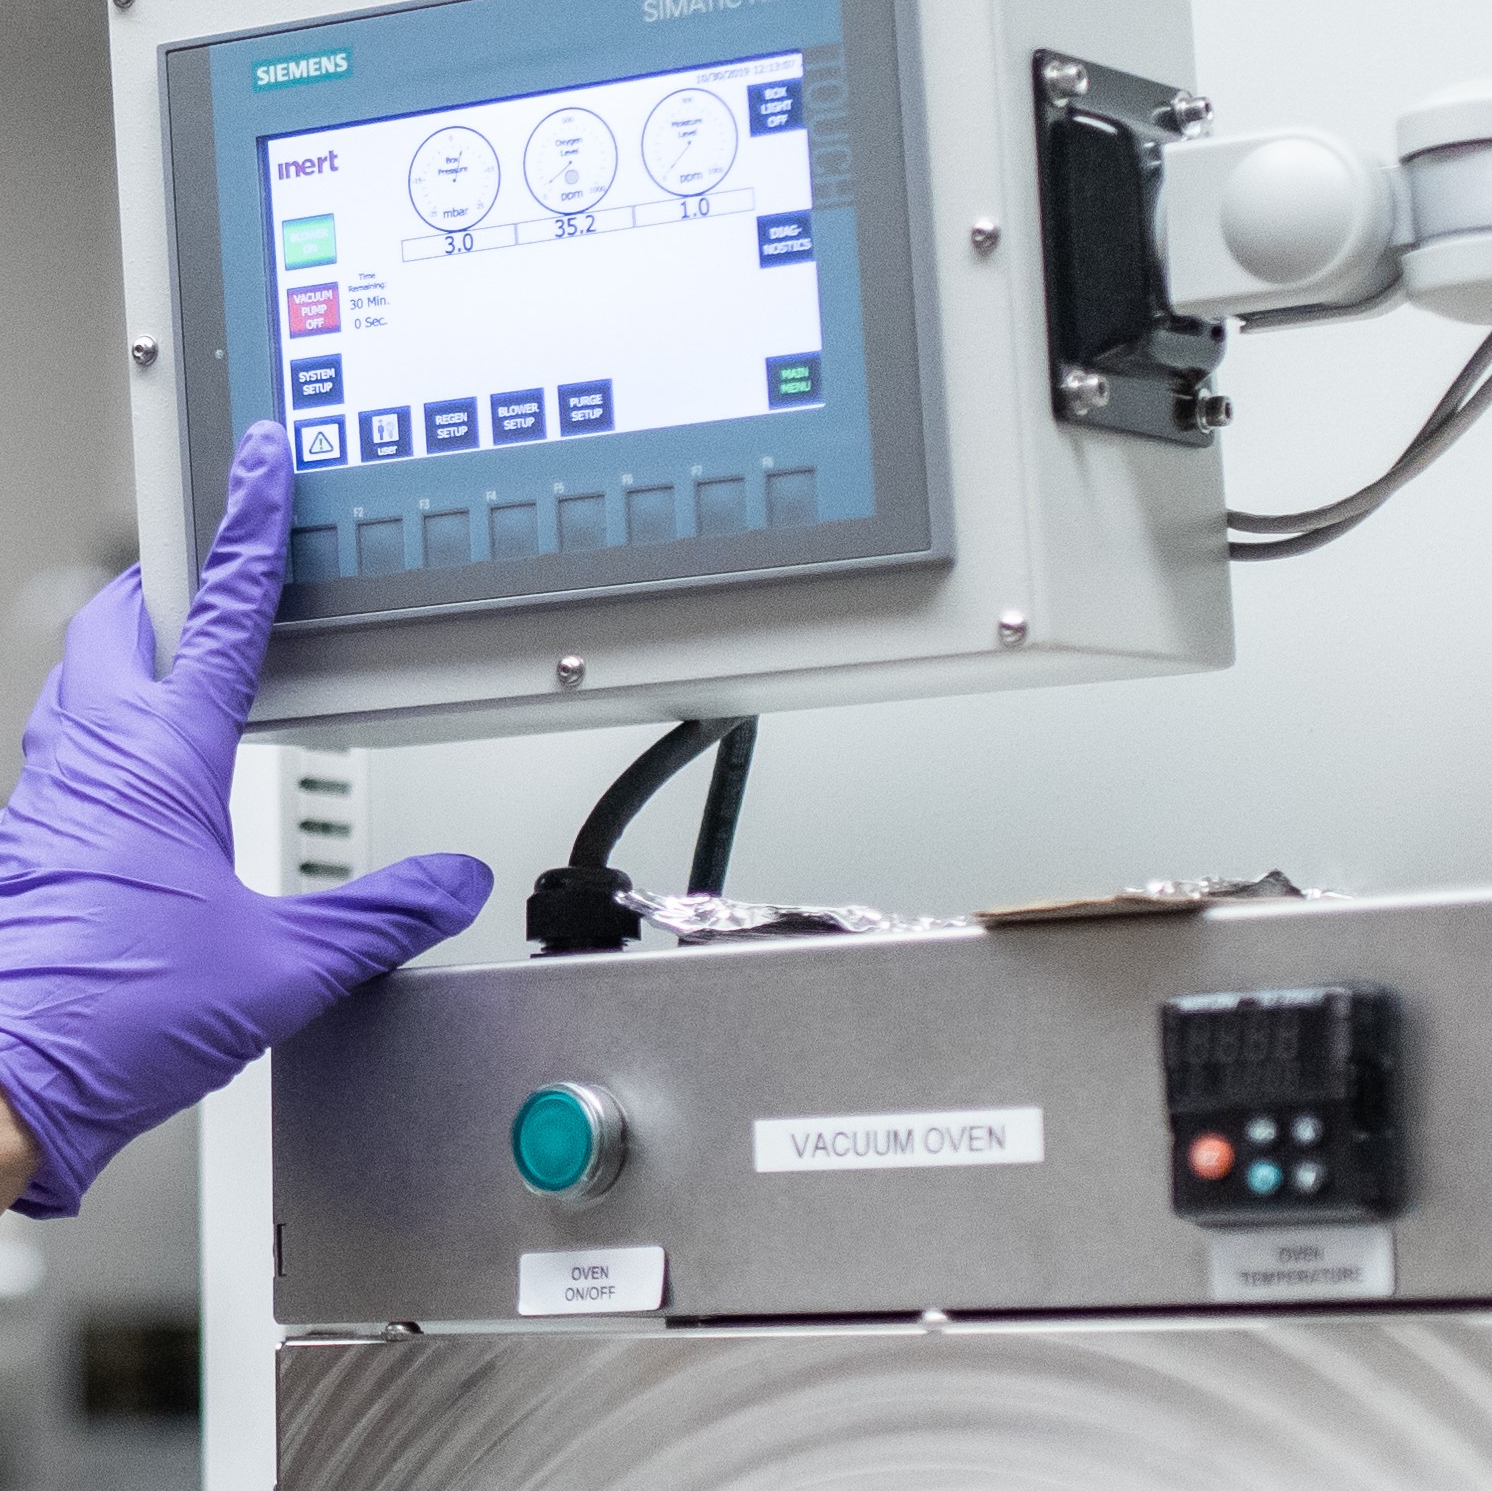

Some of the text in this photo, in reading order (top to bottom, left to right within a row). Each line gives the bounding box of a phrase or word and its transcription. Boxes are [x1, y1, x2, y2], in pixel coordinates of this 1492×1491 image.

[257, 53, 348, 85] SIEMENS
[767, 114, 789, 128] OFF
[443, 207, 469, 219] mbar
[680, 197, 710, 219] 1.0
[554, 214, 597, 239] 35.2
[444, 232, 474, 255] 3.0
[293, 289, 333, 305] VACUUM
[349, 296, 390, 310] 30 Min.
[301, 304, 328, 317] PUMP
[305, 317, 325, 330] OFF
[354, 318, 362, 329] 0
[298, 368, 336, 383] SYSTEM
[302, 382, 333, 396] SETUP
[569, 394, 604, 408] PURGE
[497, 402, 539, 418] BLOWER
[570, 408, 604, 422] SETUP
[435, 412, 468, 426] REGEN
[503, 417, 535, 431] SETUP
[436, 425, 469, 439] SETUP
[377, 445, 398, 457] user
[553, 482, 565, 494] F5
[485, 490, 497, 502] F4
[419, 498, 430, 509] F3
[353, 506, 364, 518] F2
[791, 1125, 1007, 1158] VACUUM OVEN
[571, 1266, 609, 1281] OVEN
[565, 1285, 616, 1302] ON/OFF
